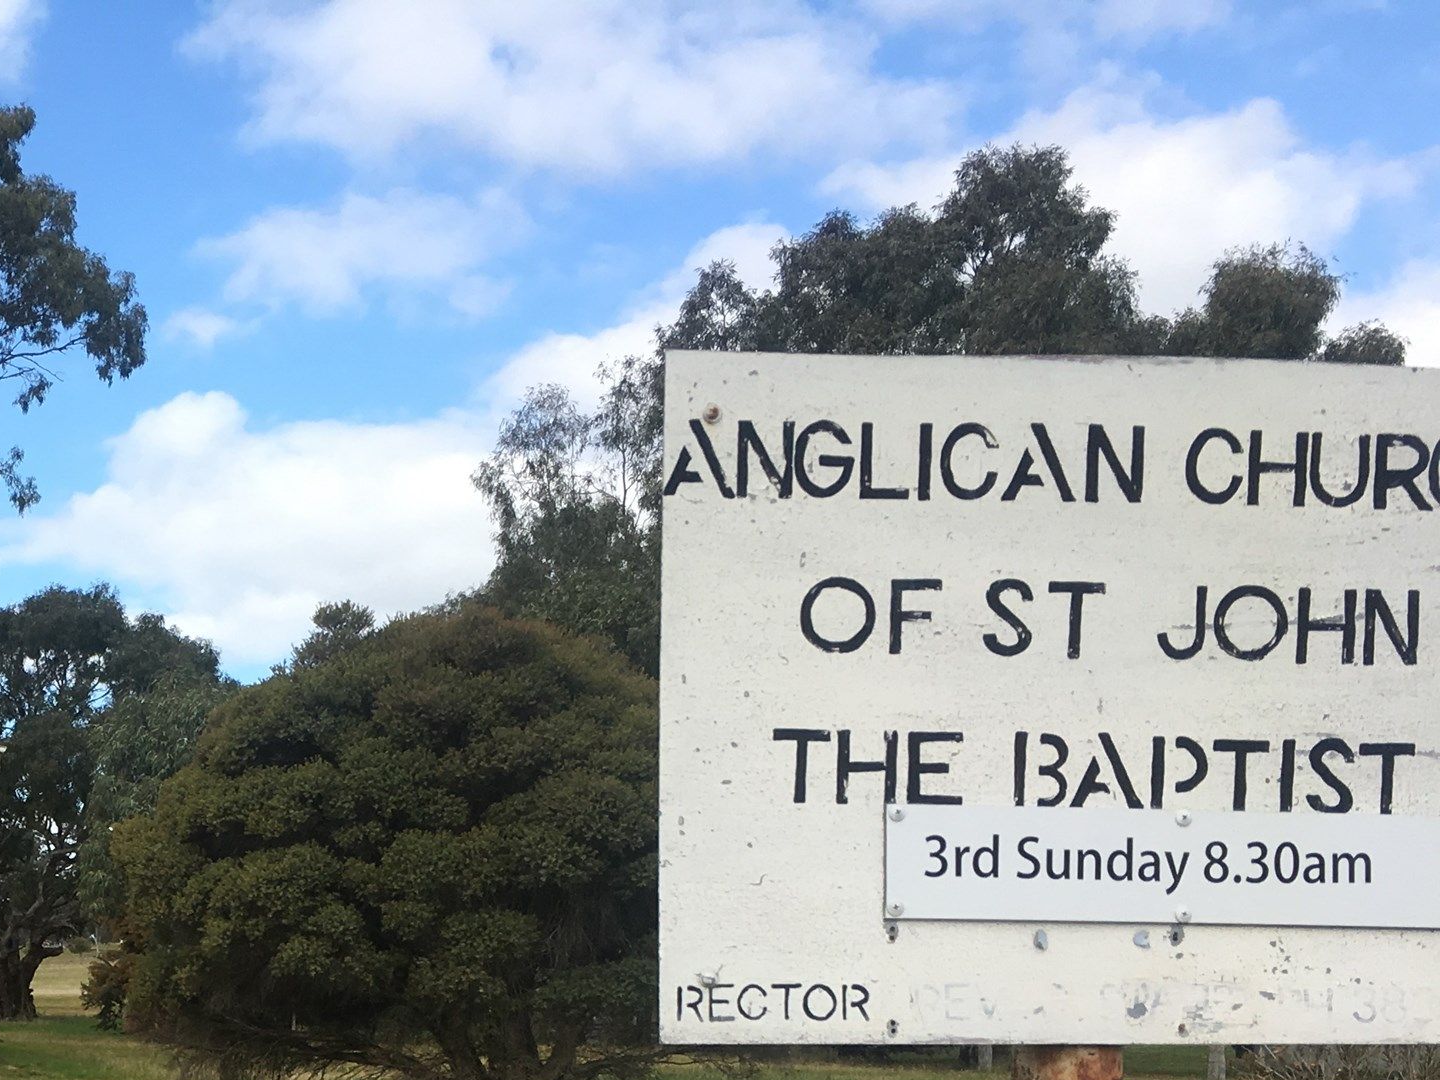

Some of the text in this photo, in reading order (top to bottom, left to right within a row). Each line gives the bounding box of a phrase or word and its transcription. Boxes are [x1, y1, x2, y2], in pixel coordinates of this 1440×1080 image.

[663, 419, 1440, 511] ANGLICAN CHUR
[800, 576, 1420, 667] OF ST JOHN
[773, 728, 1416, 816] THE BAPTIST
[924, 834, 1373, 895] 3rd Sunday 8.30am
[676, 982, 871, 1023] RECTOR
